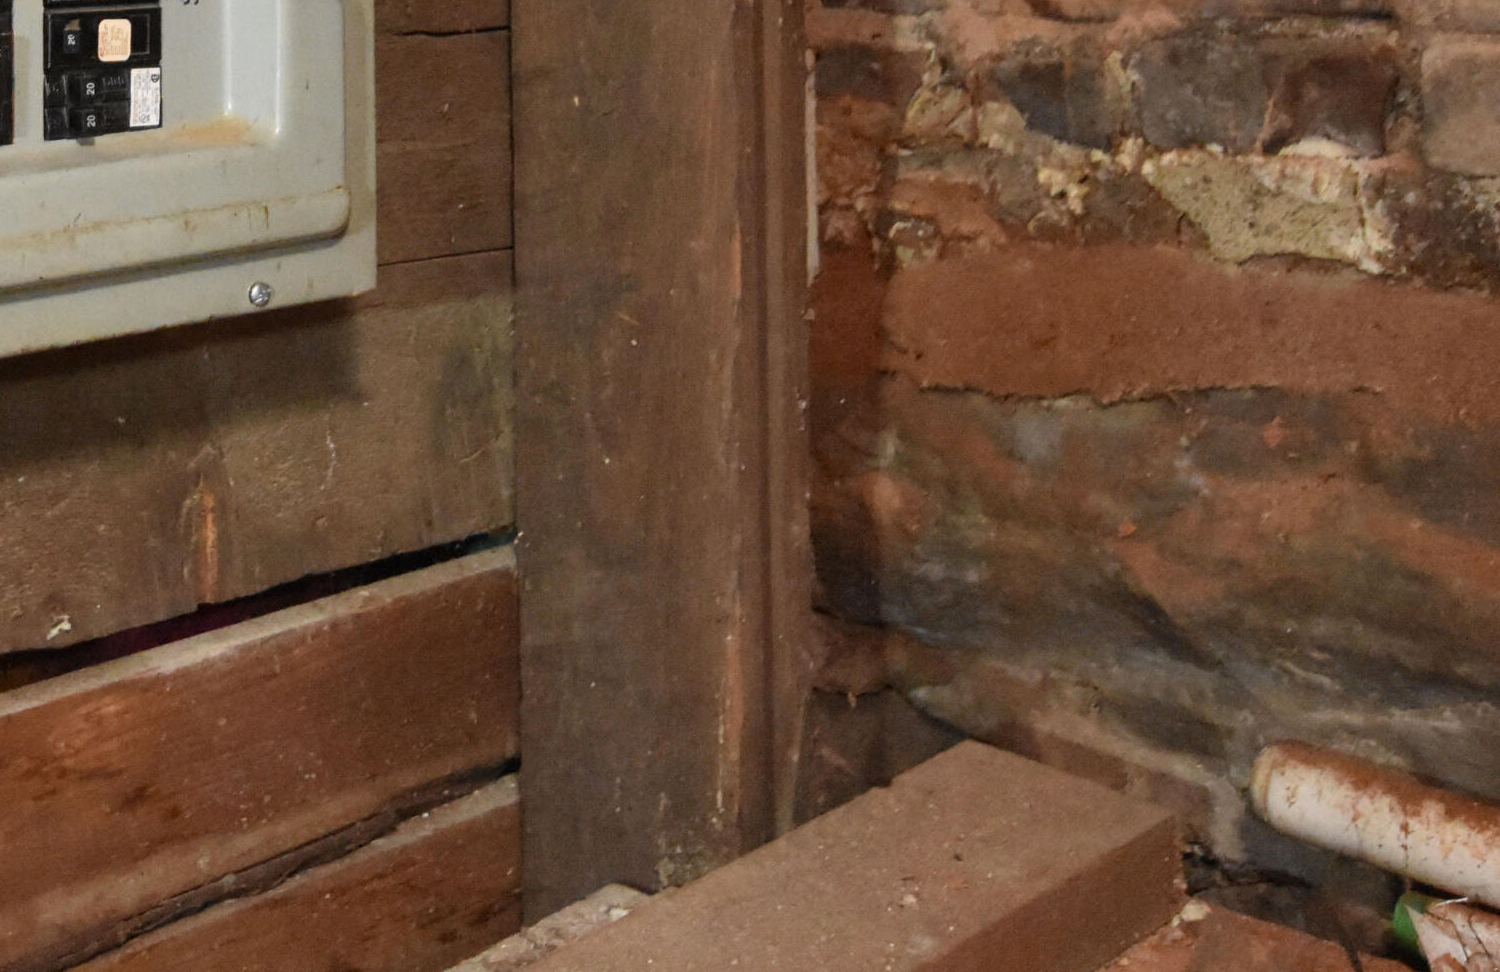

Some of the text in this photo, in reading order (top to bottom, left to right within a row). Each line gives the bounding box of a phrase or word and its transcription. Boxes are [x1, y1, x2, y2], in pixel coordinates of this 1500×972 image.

[68, 34, 76, 46] 20
[87, 82, 95, 95] 20
[87, 115, 96, 127] 20
